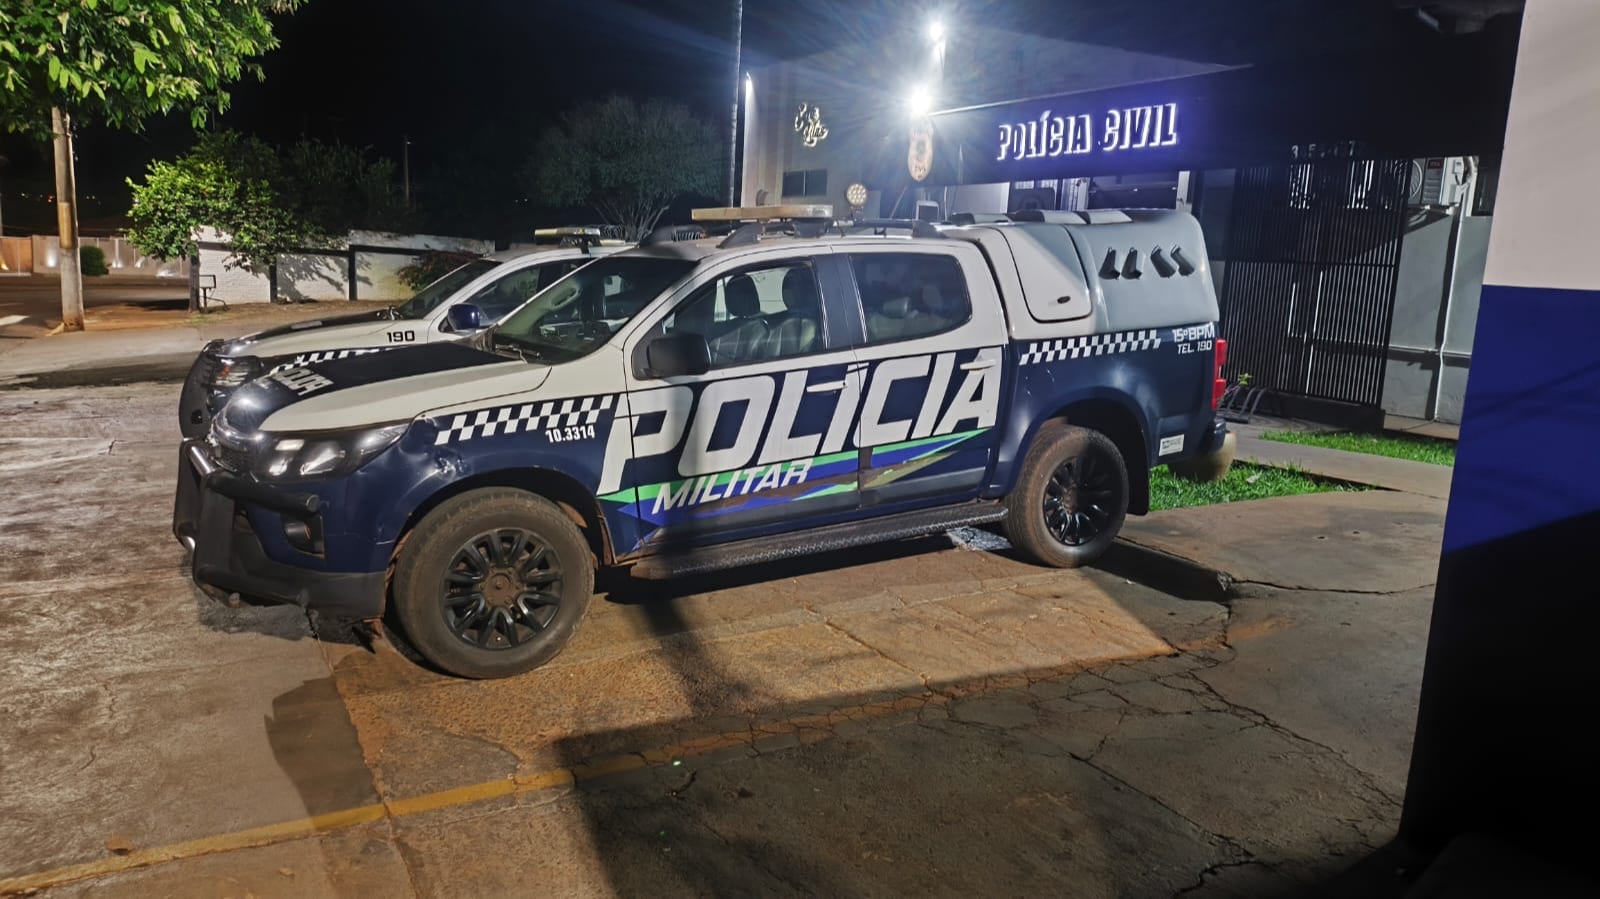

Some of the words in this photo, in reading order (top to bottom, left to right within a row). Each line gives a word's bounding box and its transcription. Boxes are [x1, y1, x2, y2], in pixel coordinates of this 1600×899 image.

[996, 110, 1092, 161] POLÍCIA
[1099, 102, 1178, 151] CIVIL
[387, 330, 416, 343] 190
[1177, 343, 1195, 355] TEL.
[1197, 339, 1213, 352] 190
[544, 424, 596, 444] 10.3314
[597, 346, 1003, 496] POLÍCIA
[651, 458, 814, 516] MILITAR
